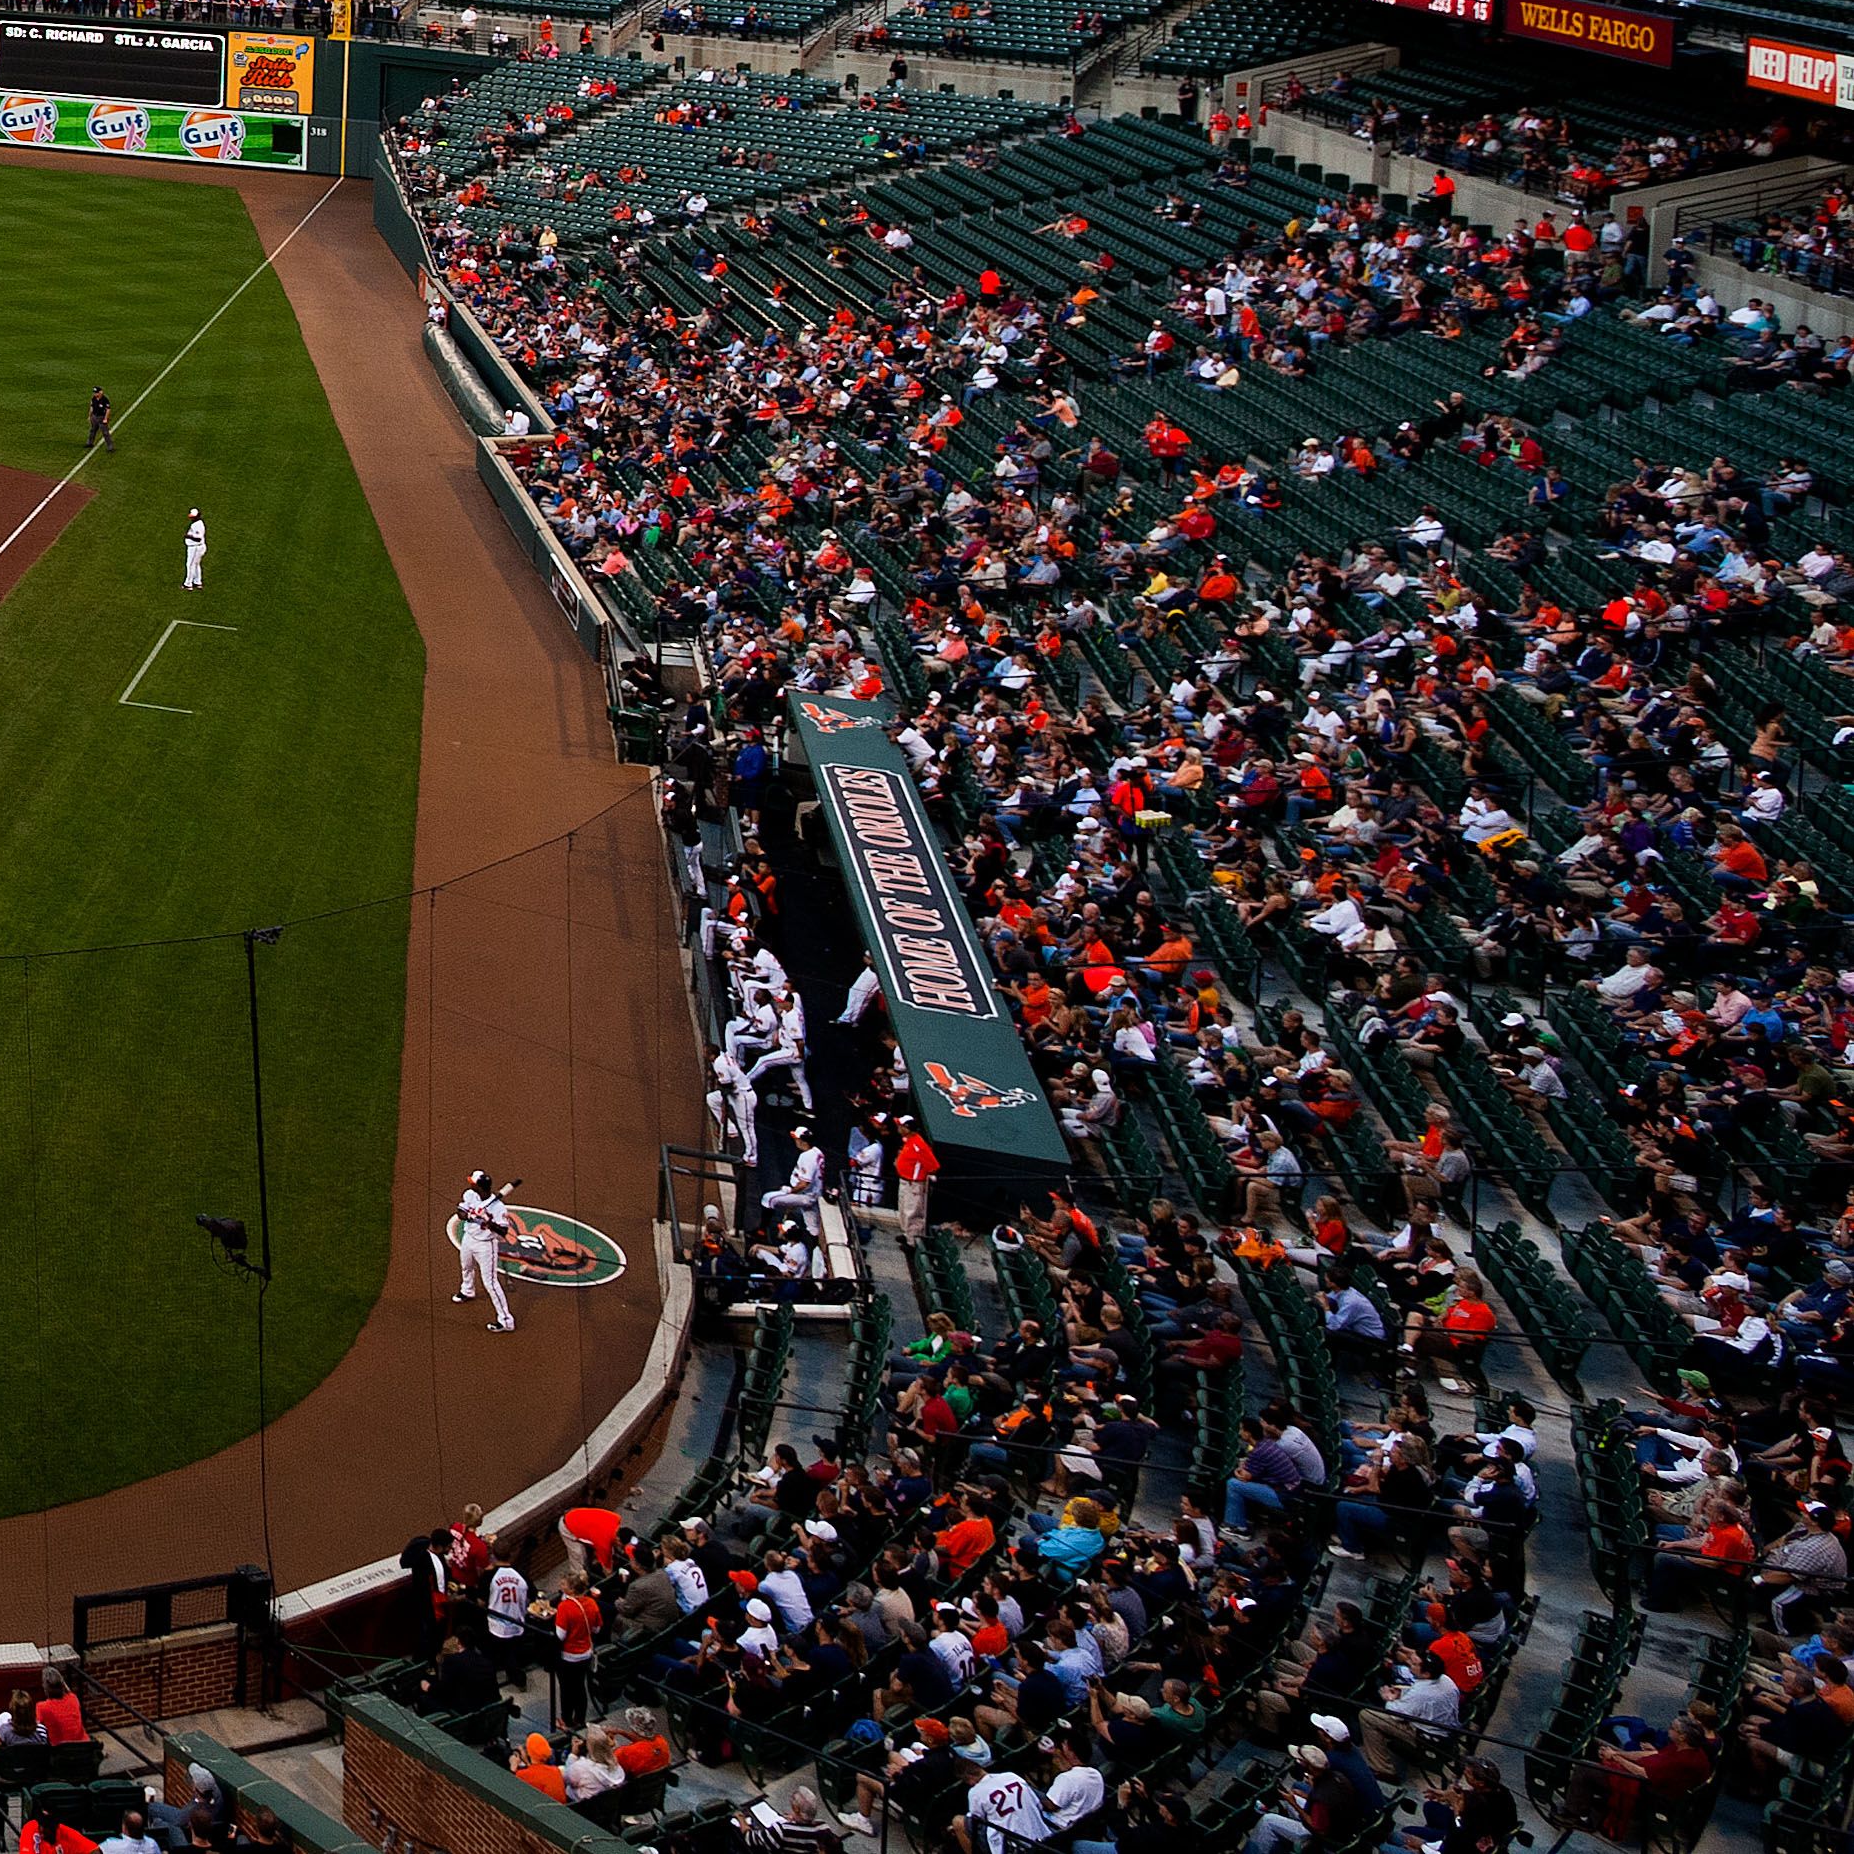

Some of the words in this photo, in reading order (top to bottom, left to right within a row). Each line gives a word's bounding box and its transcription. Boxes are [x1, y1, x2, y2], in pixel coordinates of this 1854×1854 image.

[1472, 1, 1488, 20] 15
[5, 26, 27, 38] SD:
[29, 28, 43, 39] C.
[45, 29, 104, 44] RICHARD
[115, 33, 144, 47] STL:
[146, 36, 159, 48] J.
[160, 37, 214, 52] GARCIA
[1521, 2, 1585, 38] WELLS
[1588, 16, 1655, 53] FARGO
[248, 55, 297, 72] Strike
[1749, 45, 1787, 83] NEED
[1788, 53, 1836, 94] HELP?
[240, 69, 295, 89] Rich
[1, 106, 52, 128] Gulf
[91, 114, 144, 136] Gulf
[184, 122, 239, 145] Gulf
[310, 127, 327, 137] 318
[833, 767, 913, 848] ORIOLES
[863, 848, 932, 896] THE
[879, 897, 945, 933] OF
[892, 933, 978, 1013] HOME
[692, 1572, 705, 1590] 2
[500, 1586, 518, 1604] 21
[959, 1657, 976, 1681] 10
[989, 1781, 1023, 1818] 27
